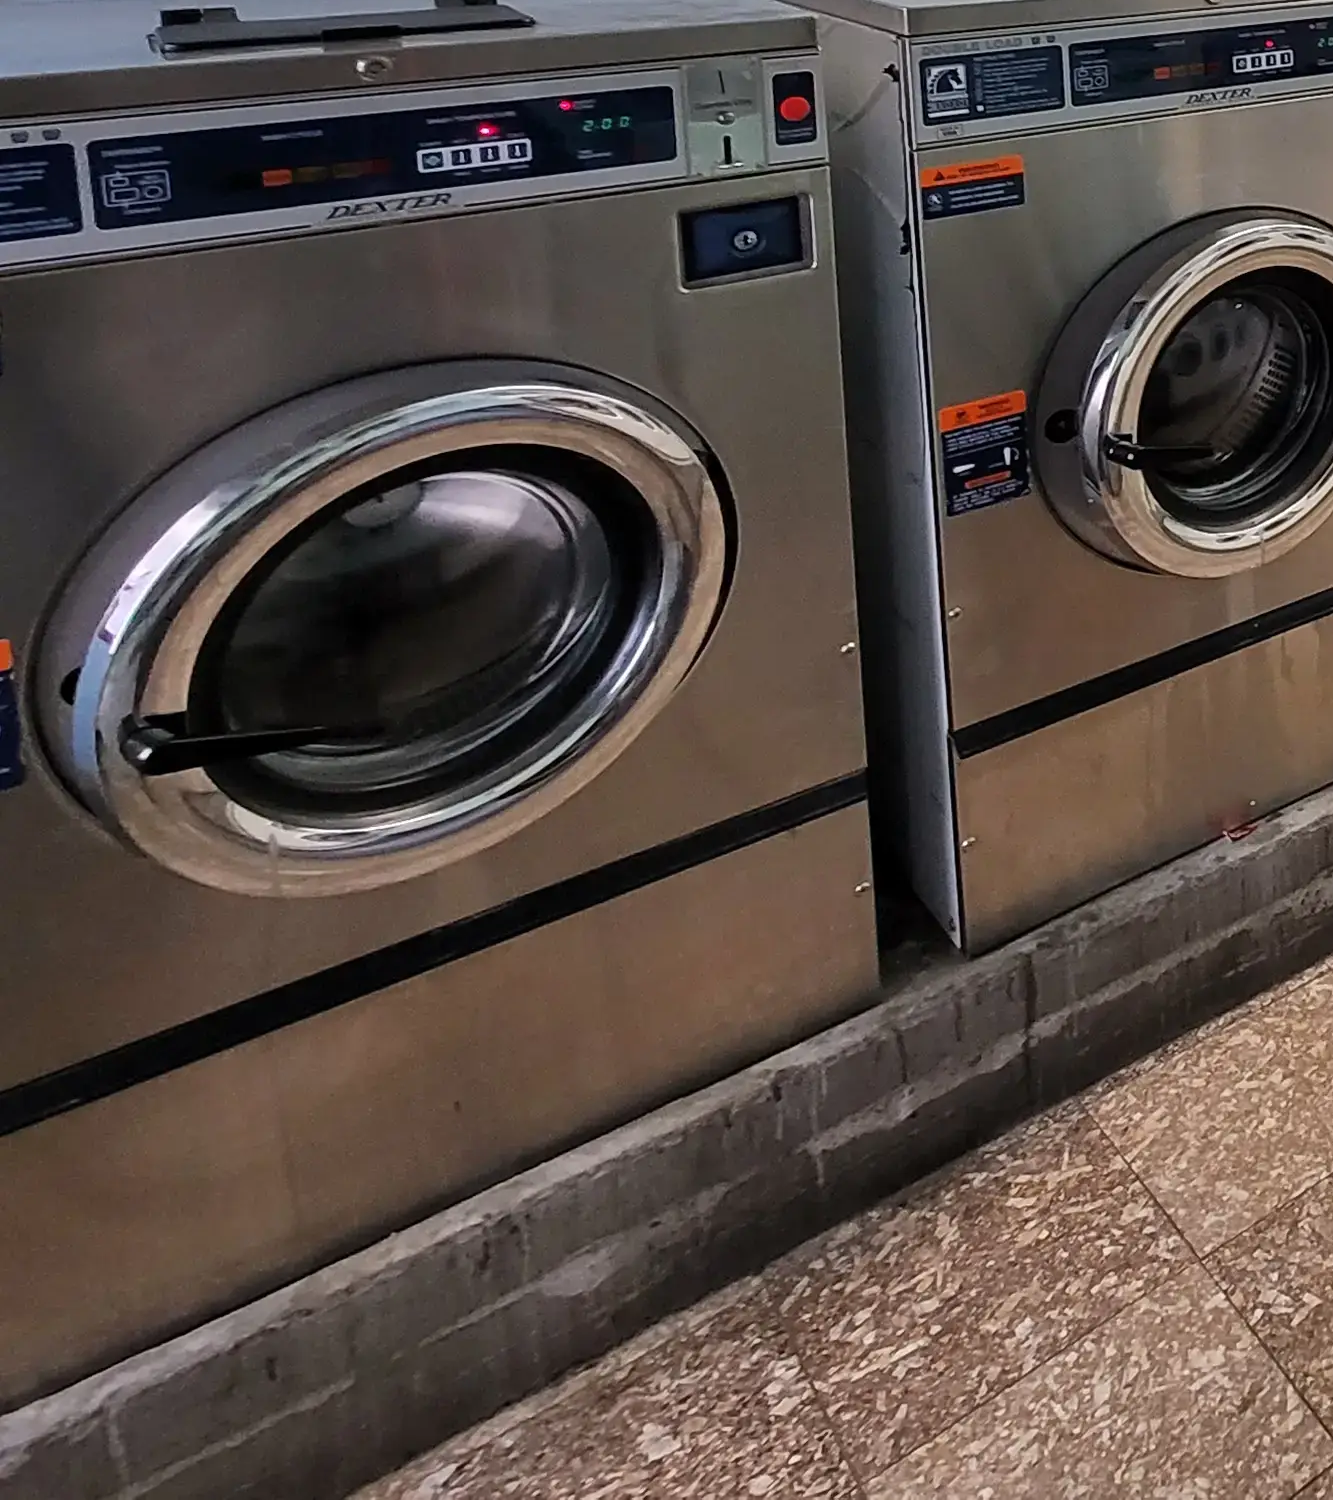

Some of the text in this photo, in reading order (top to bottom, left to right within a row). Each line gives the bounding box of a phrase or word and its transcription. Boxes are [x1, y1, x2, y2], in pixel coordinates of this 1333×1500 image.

[985, 37, 1022, 49] LOAD
[1186, 88, 1252, 105] DEXTER
[327, 193, 452, 219] DEXTER
